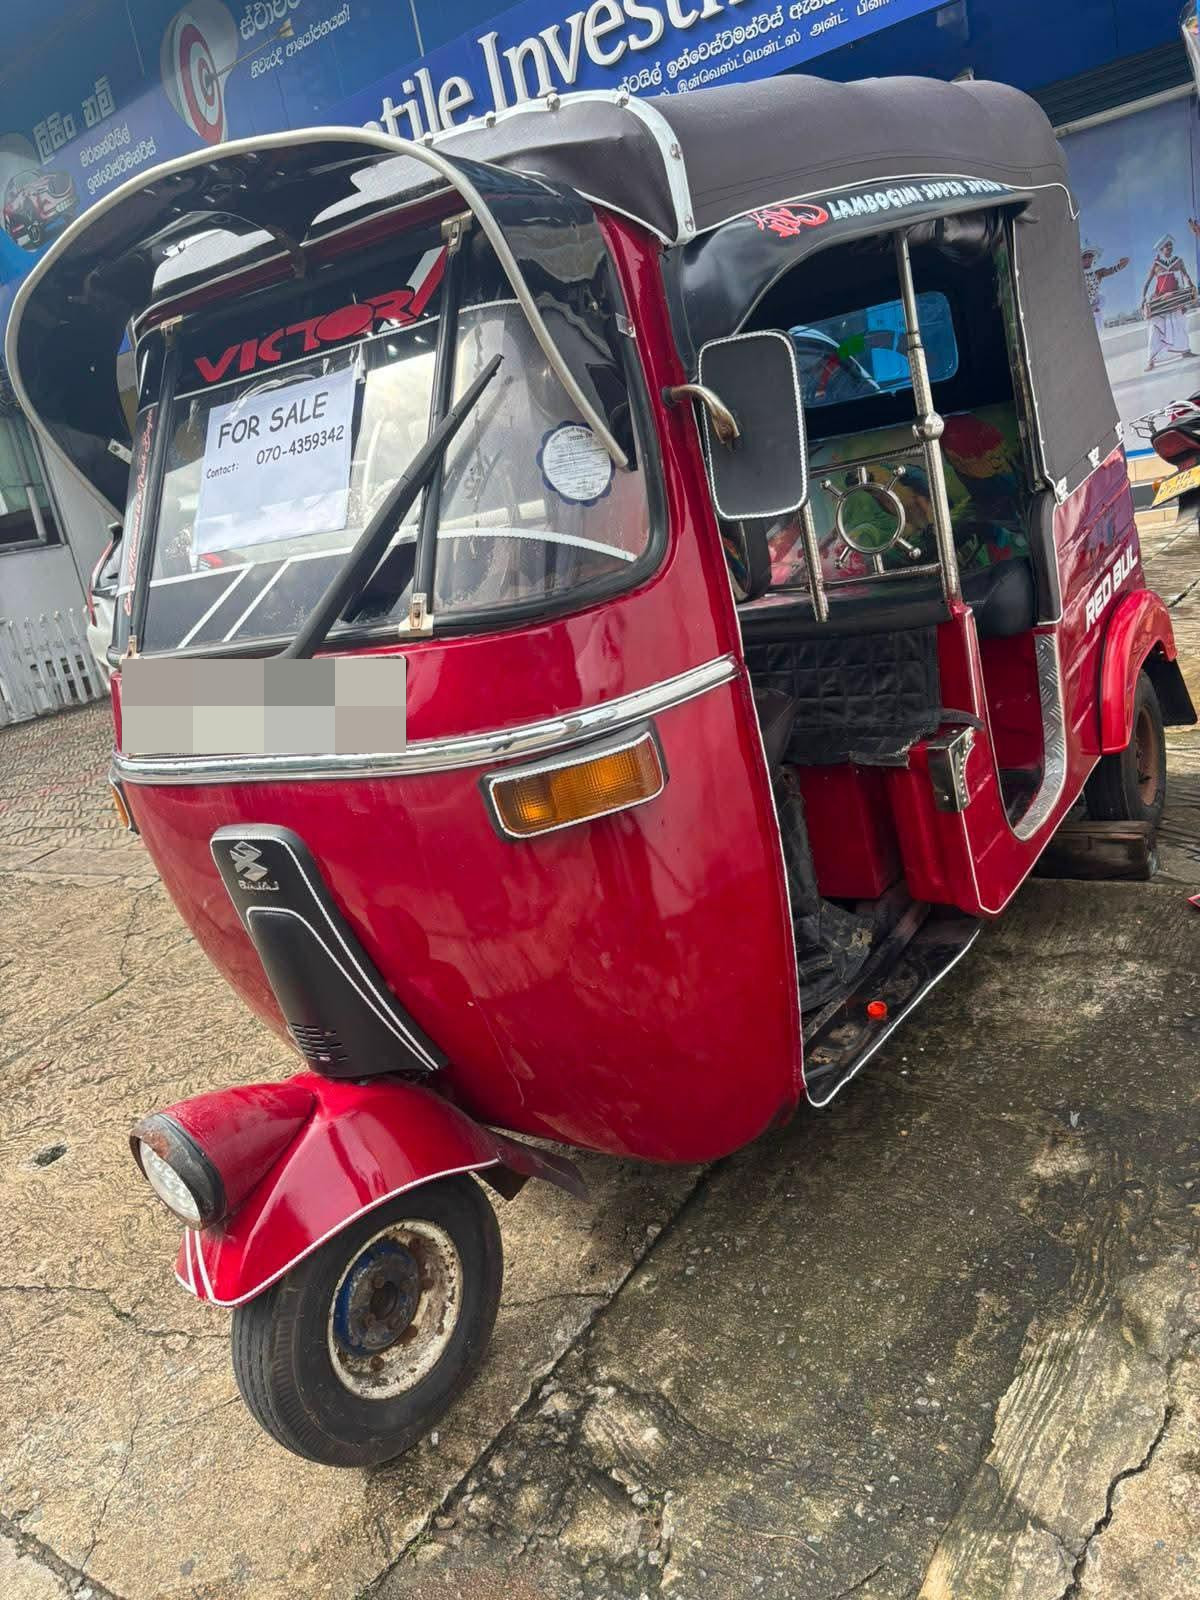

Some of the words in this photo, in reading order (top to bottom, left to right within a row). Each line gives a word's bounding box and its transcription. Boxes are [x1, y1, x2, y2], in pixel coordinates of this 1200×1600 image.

[809, 8, 849, 37] அன்ட்
[362, 66, 474, 141] tile
[477, 0, 752, 111] Inves
[921, 180, 967, 201] SUPER
[218, 414, 260, 449] FOR
[269, 391, 329, 433] SALE
[206, 462, 240, 480] Contact:
[256, 424, 344, 465] 070-4359342
[1086, 572, 1112, 633] RED
[1113, 545, 1138, 592] BUL
